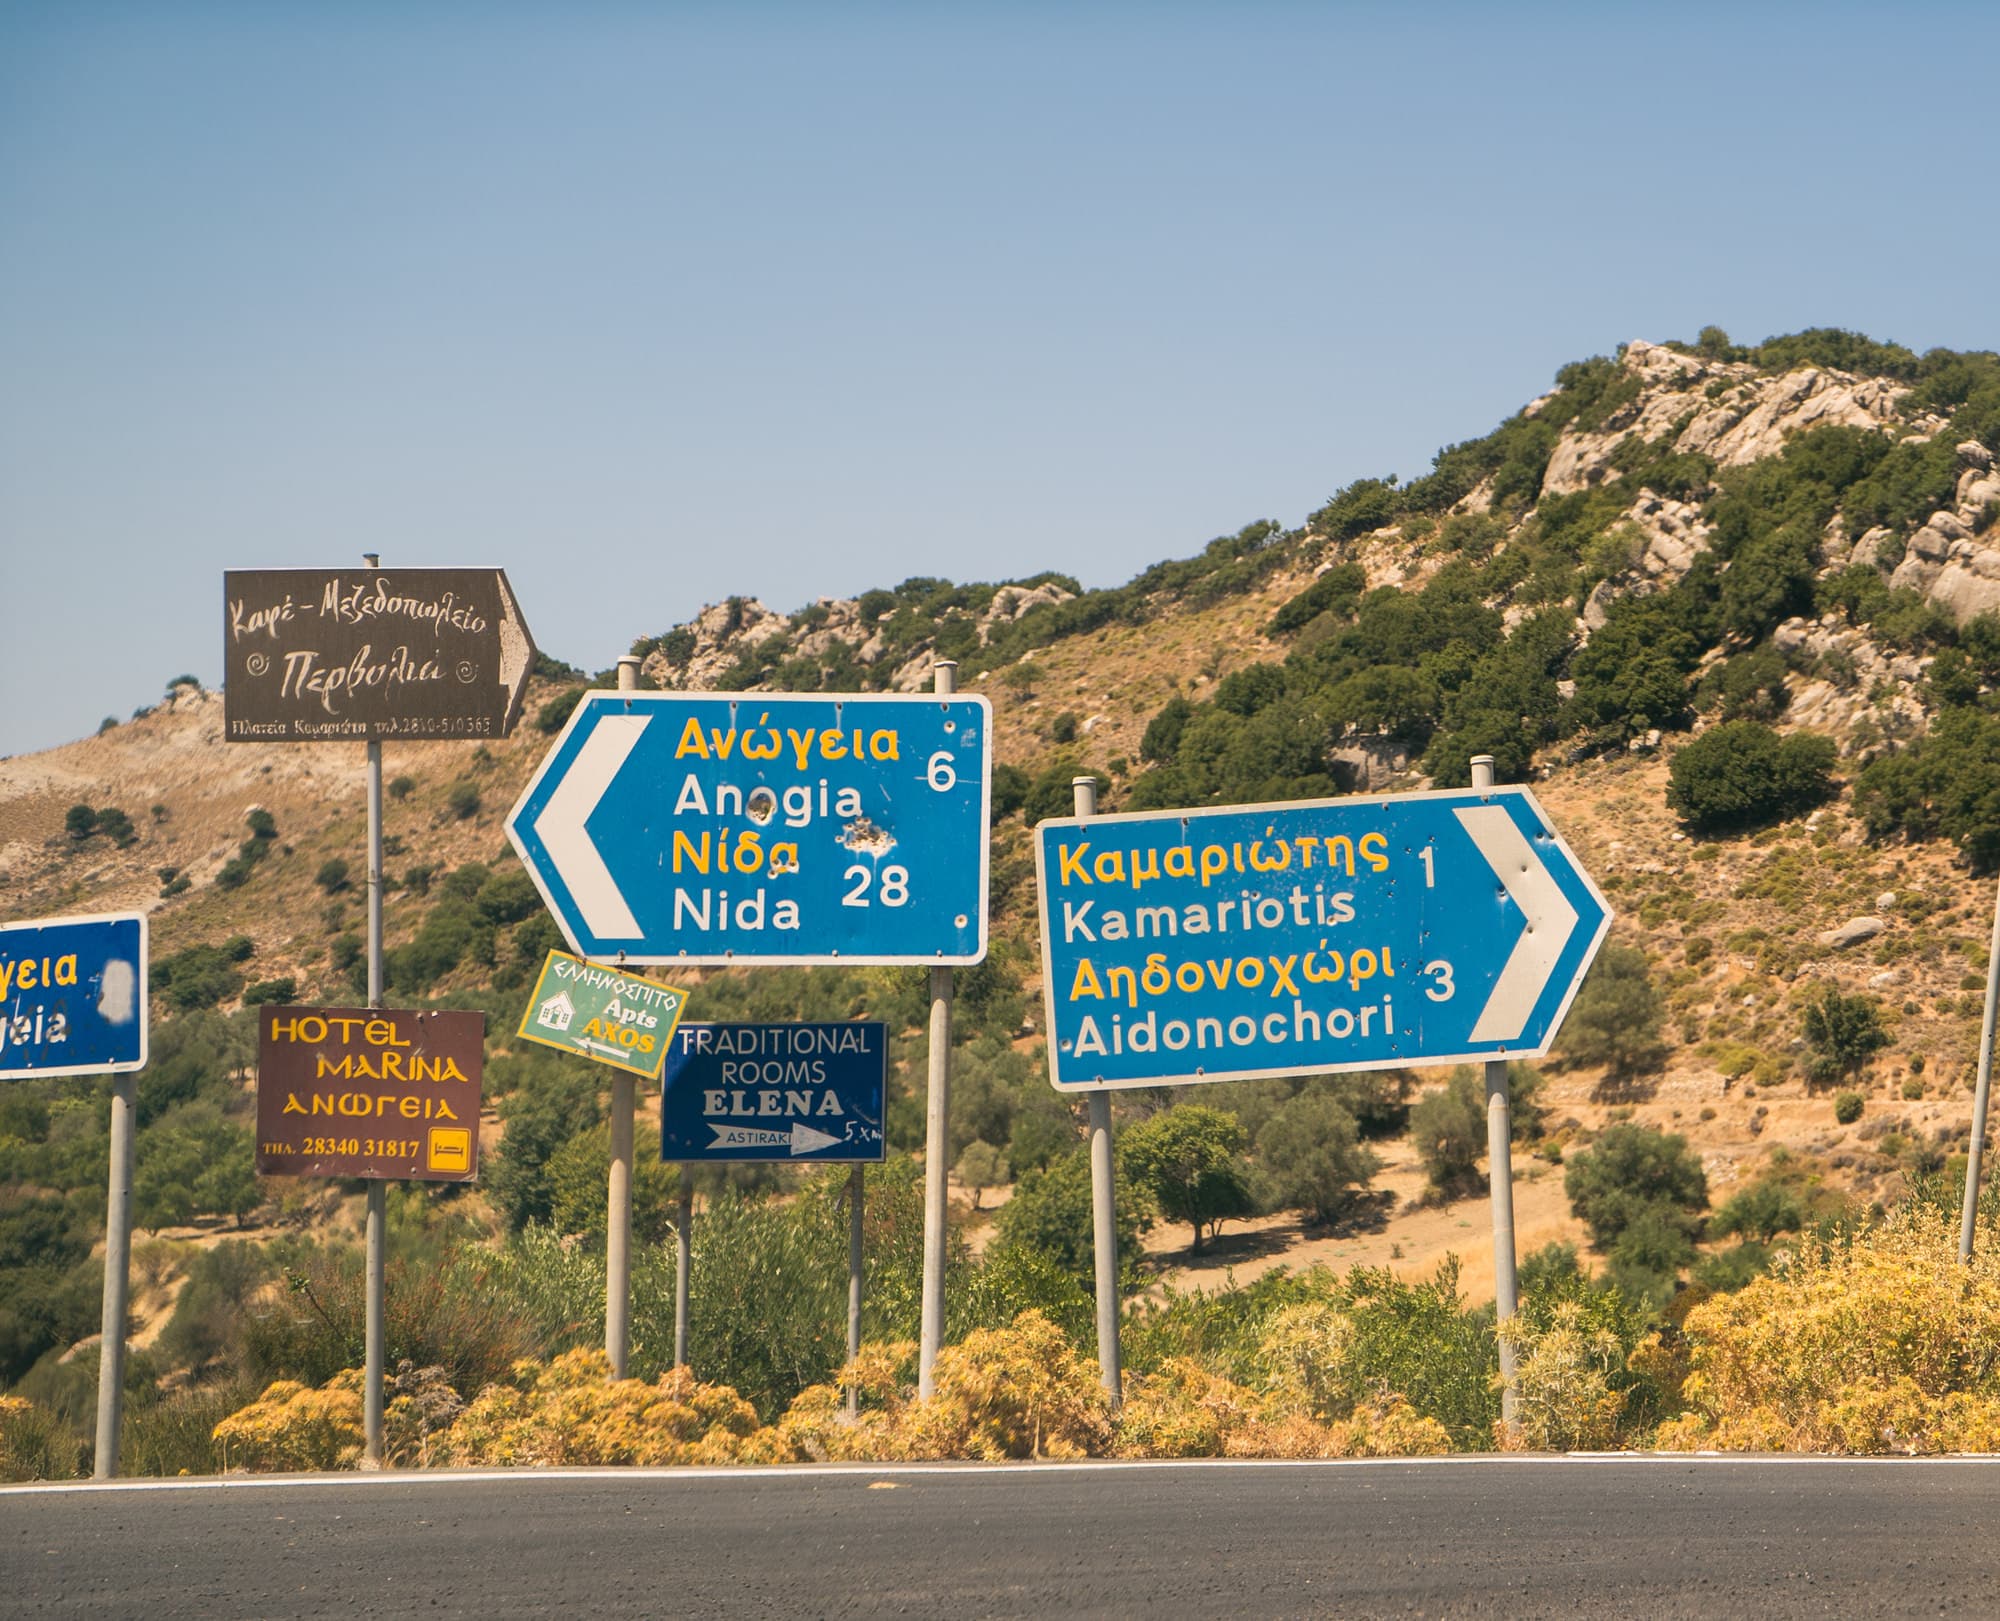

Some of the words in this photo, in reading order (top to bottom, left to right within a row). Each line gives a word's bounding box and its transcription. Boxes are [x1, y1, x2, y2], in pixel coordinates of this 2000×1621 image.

[229, 595, 296, 644] Καφέ
[319, 577, 487, 637] Μεζεδοπωλείο
[232, 719, 287, 735] Πλατεία
[674, 712, 899, 770] Ανώγεια
[927, 750, 956, 792] 6
[673, 773, 863, 828] Anogia
[672, 827, 800, 875] Νίδα
[1059, 826, 1390, 889] Καμαριώτης
[1418, 846, 1435, 888] 1
[841, 864, 910, 907] 28
[673, 887, 801, 930] Nida
[1063, 884, 1356, 943] Kamariotis
[1069, 939, 1395, 1008] Αηδονοχώρι
[1424, 960, 1456, 1003] 3
[271, 1016, 411, 1047] HOTEL
[604, 998, 658, 1029] Apts
[1072, 994, 1394, 1058] Aidonochori
[582, 1017, 656, 1054] AXOS
[677, 1027, 871, 1056] TRADITIONAL
[316, 1051, 469, 1082] MARINA
[721, 1060, 826, 1085] ROOMS
[702, 1089, 845, 1117] ELENA
[302, 1137, 360, 1156] 28340
[363, 1138, 420, 1158] 31817
[726, 1131, 792, 1145] ASTIRAKI
